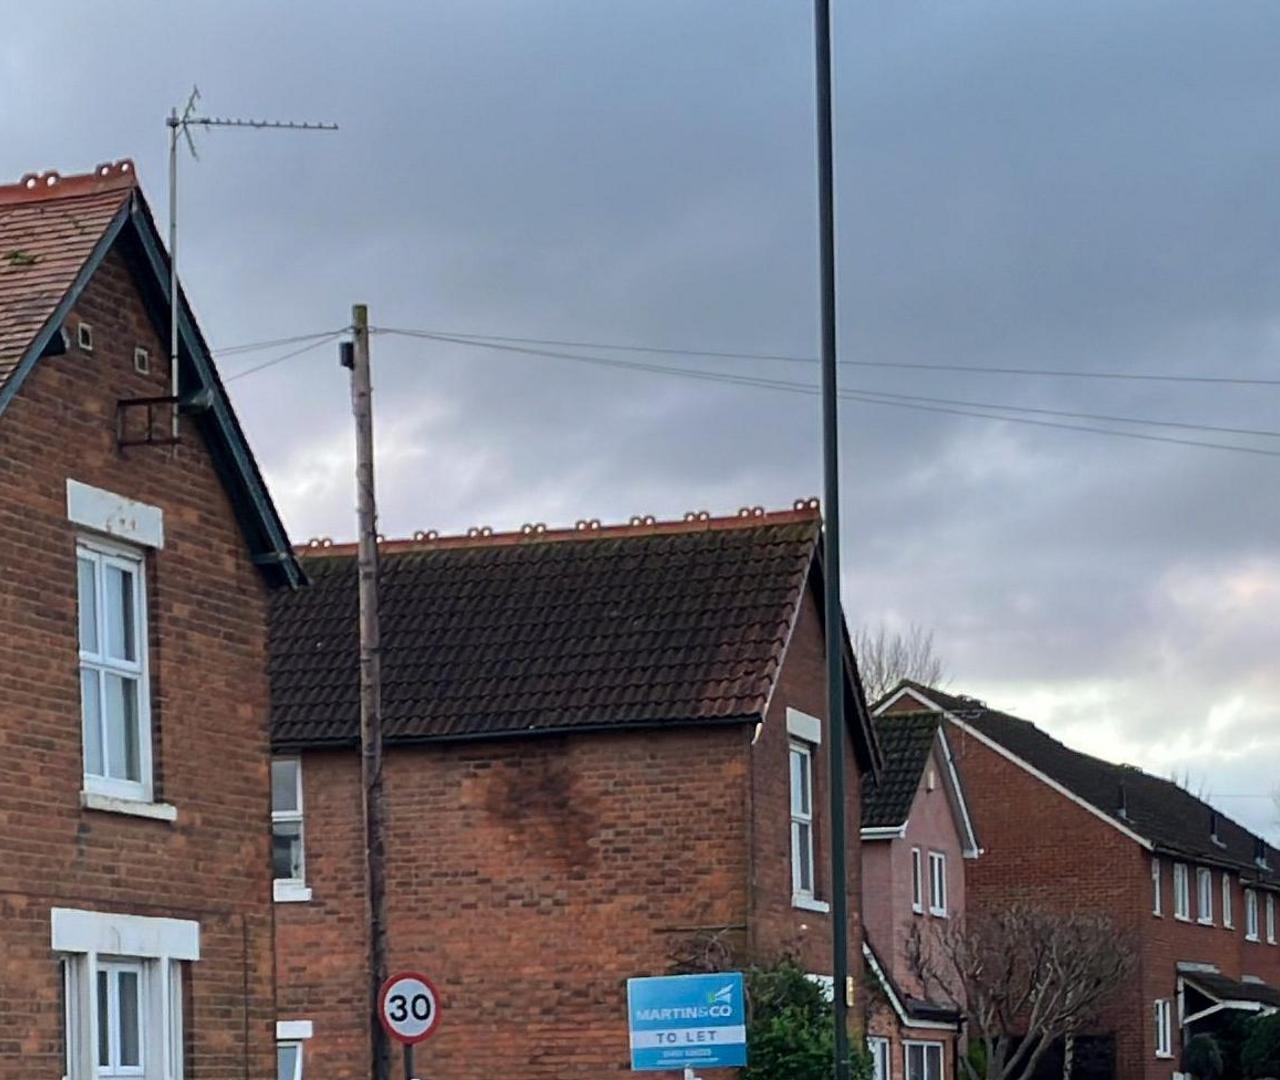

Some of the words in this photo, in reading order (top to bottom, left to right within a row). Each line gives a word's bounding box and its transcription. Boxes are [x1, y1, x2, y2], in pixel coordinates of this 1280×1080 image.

[389, 993, 431, 1022] 30
[656, 1032, 677, 1043] TO
[686, 1030, 718, 1042] LET
